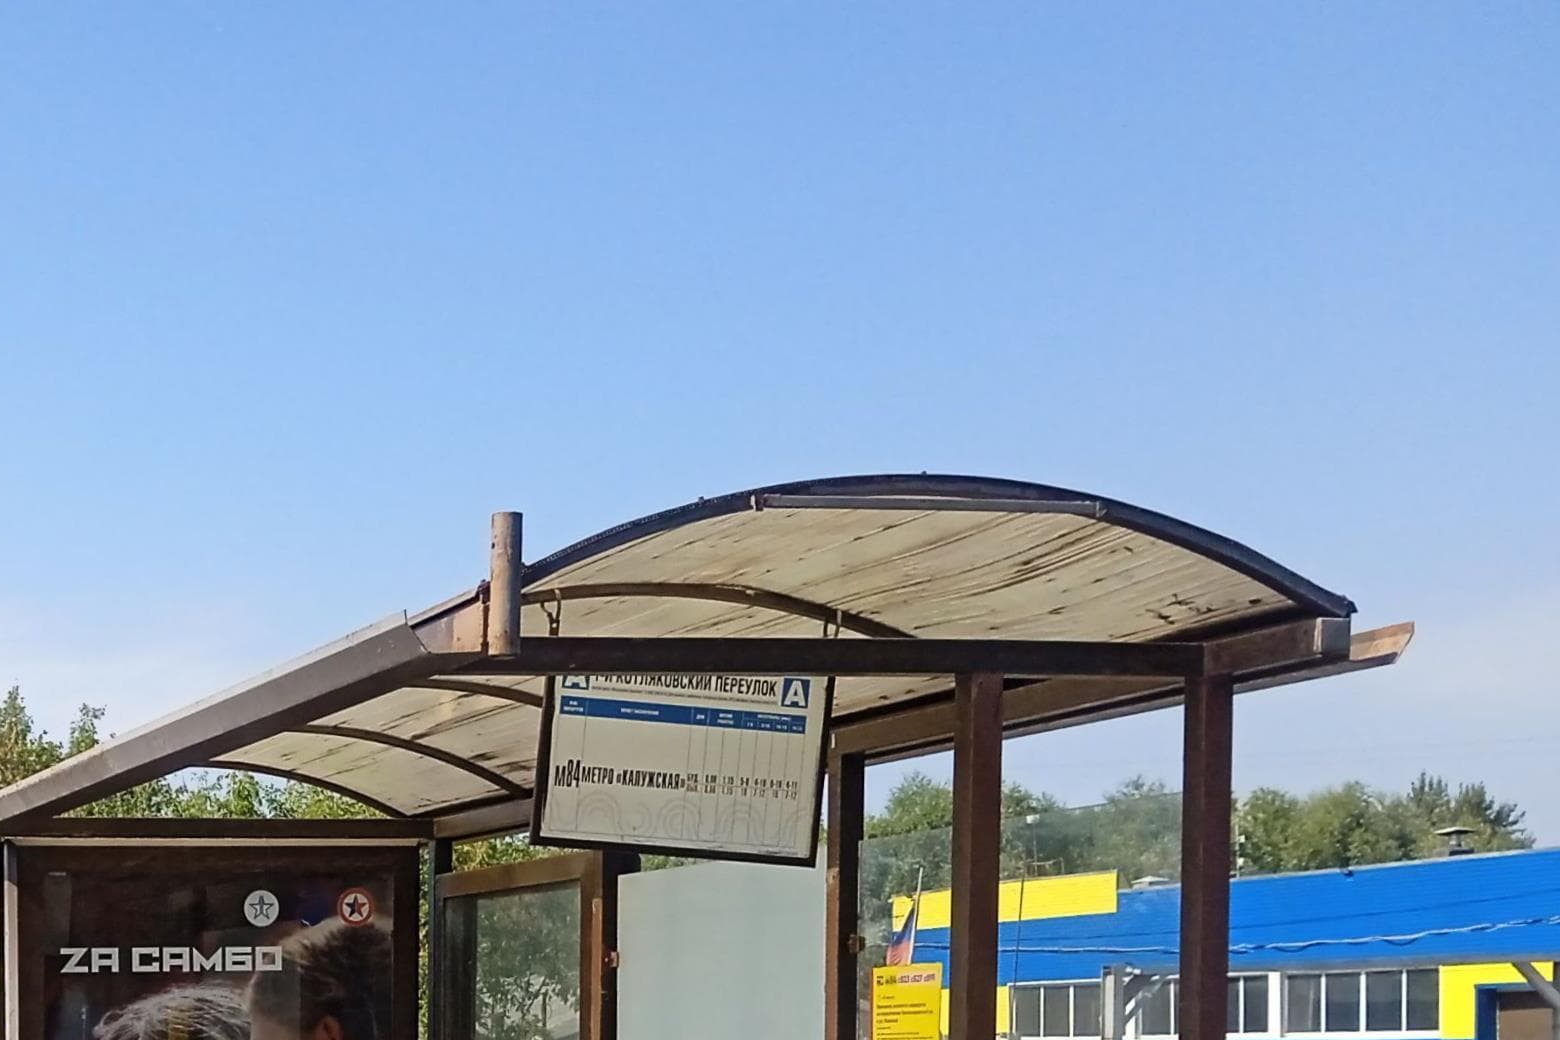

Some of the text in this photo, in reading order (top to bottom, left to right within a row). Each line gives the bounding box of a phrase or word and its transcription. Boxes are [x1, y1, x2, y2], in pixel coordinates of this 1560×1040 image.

[715, 676, 777, 696] ПЕРЕУЛОК
[581, 766, 614, 784] МЕТРО
[616, 769, 686, 789] «КАЛУЖСКАЯ»
[131, 946, 283, 973] САМБО
